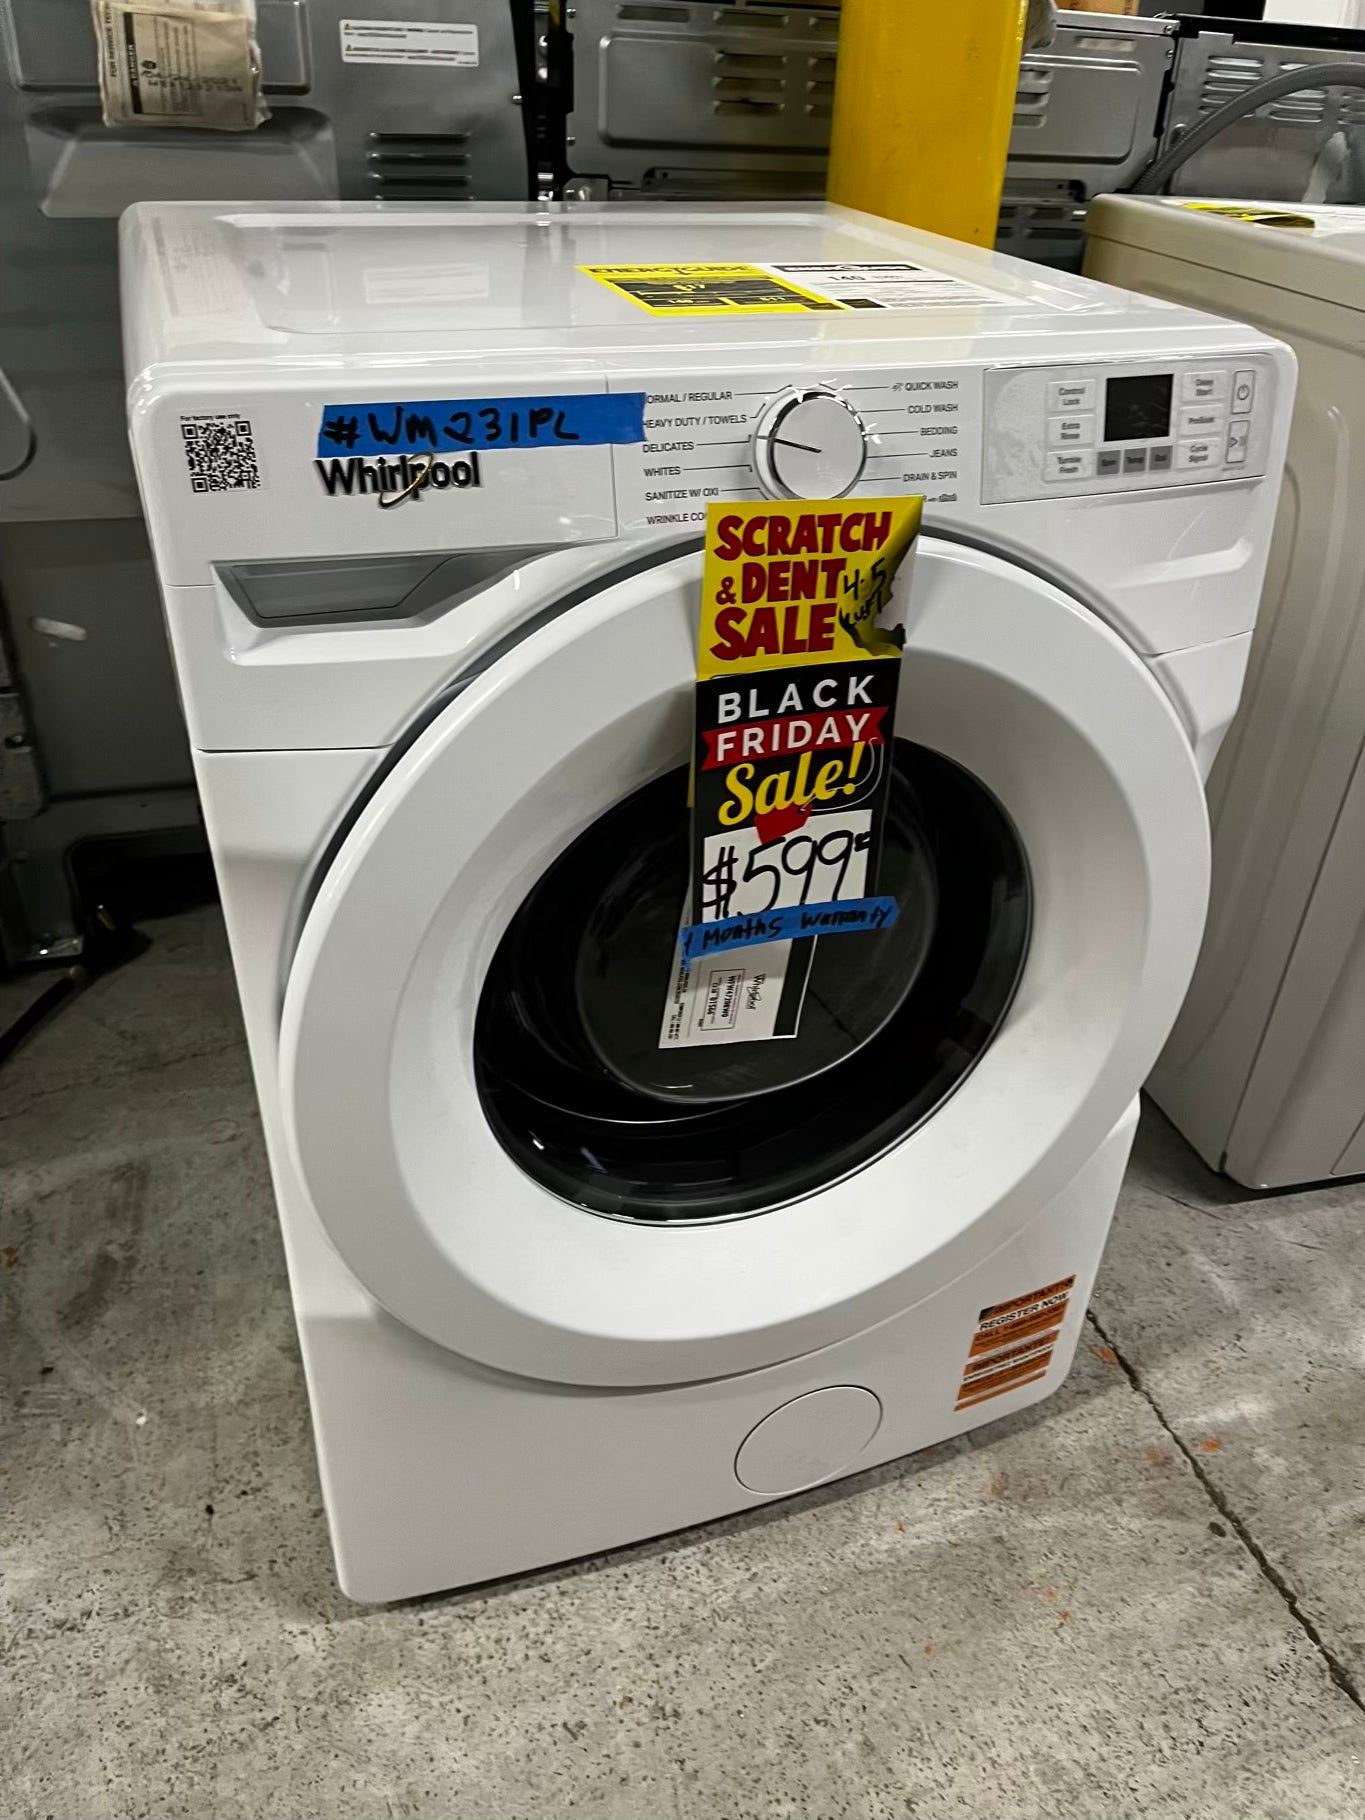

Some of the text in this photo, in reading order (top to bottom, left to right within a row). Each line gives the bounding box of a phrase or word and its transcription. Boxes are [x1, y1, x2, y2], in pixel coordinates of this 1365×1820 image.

[904, 381, 958, 391] QUICK WASH
[646, 395, 682, 404] ORMAL
[688, 391, 732, 401] REGULAR
[907, 404, 958, 413] COLD WASH
[643, 418, 673, 428] HEAVY
[675, 416, 701, 426] DUTY
[708, 414, 748, 424] TOWELS
[920, 426, 958, 436] BEDDING
[642, 441, 694, 453] DELICATES
[929, 448, 958, 458] JEANS
[643, 466, 682, 477] WHITES
[903, 471, 958, 482] DRAIN & SPIN
[314, 451, 482, 507] Whirlpool
[645, 487, 719, 501] SANITIZE W/ OXI
[646, 511, 706, 525] WRINKLE CO
[713, 511, 892, 562] SCRATCH
[715, 558, 847, 605] & DENT
[710, 602, 838, 661] SALE
[717, 675, 875, 724] BLACK
[717, 713, 871, 762] FRIDAY
[718, 741, 866, 826] Sale!
[746, 972, 767, 1010] Whirlpool
[979, 1303, 1040, 1331] REGISTER
[1038, 1292, 1071, 1310] NOW
